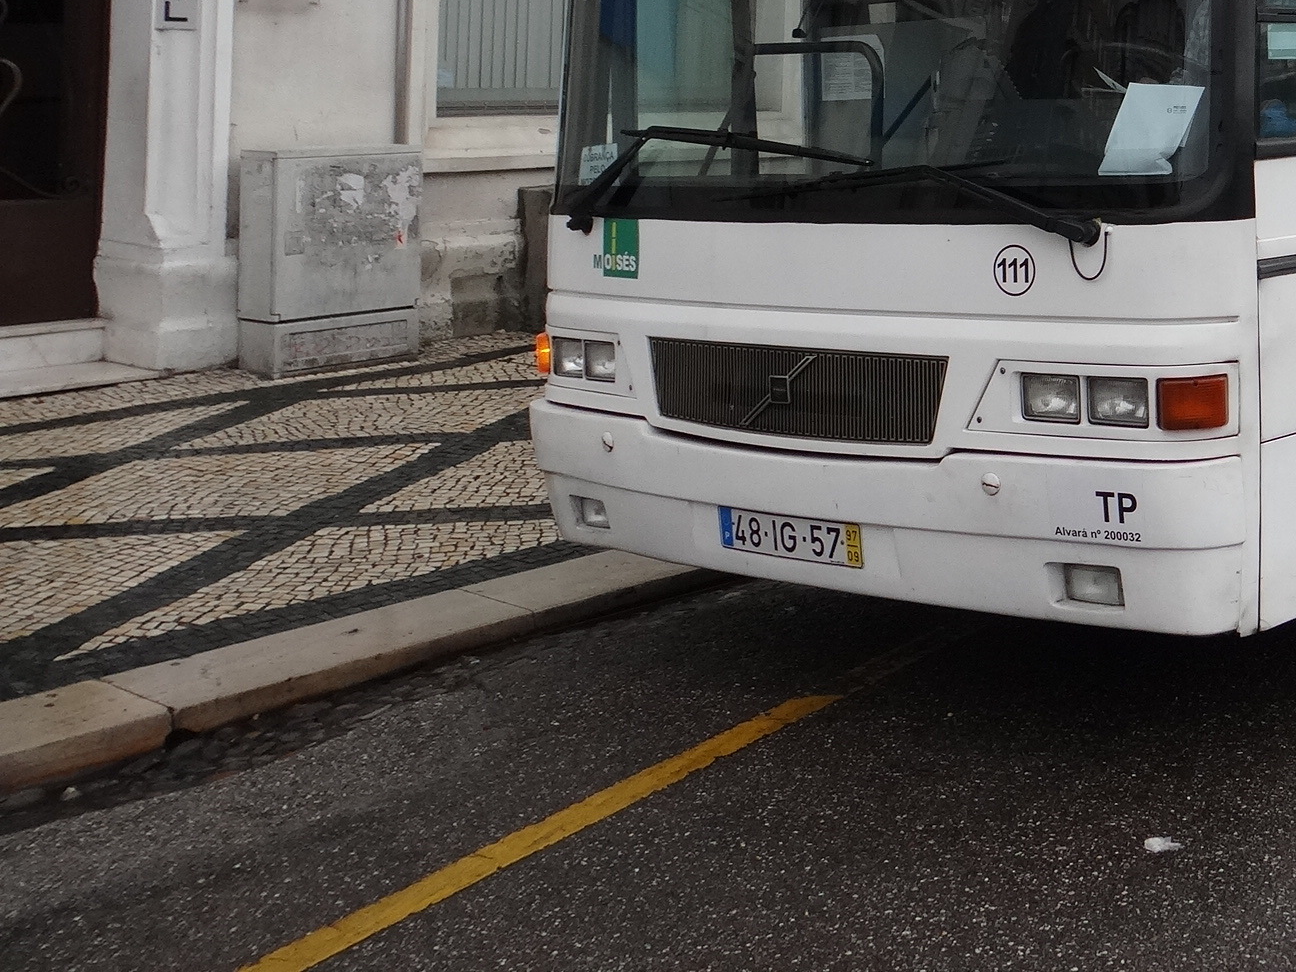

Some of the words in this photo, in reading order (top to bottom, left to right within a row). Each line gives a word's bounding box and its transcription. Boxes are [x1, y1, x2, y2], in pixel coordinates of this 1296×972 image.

[593, 251, 637, 272] MOISÉS
[997, 258, 1029, 283] 111
[1095, 490, 1138, 524] TP
[845, 529, 857, 542] 97
[1055, 526, 1088, 538] Alvará
[1104, 530, 1142, 542] 200032
[847, 550, 860, 563] 09
